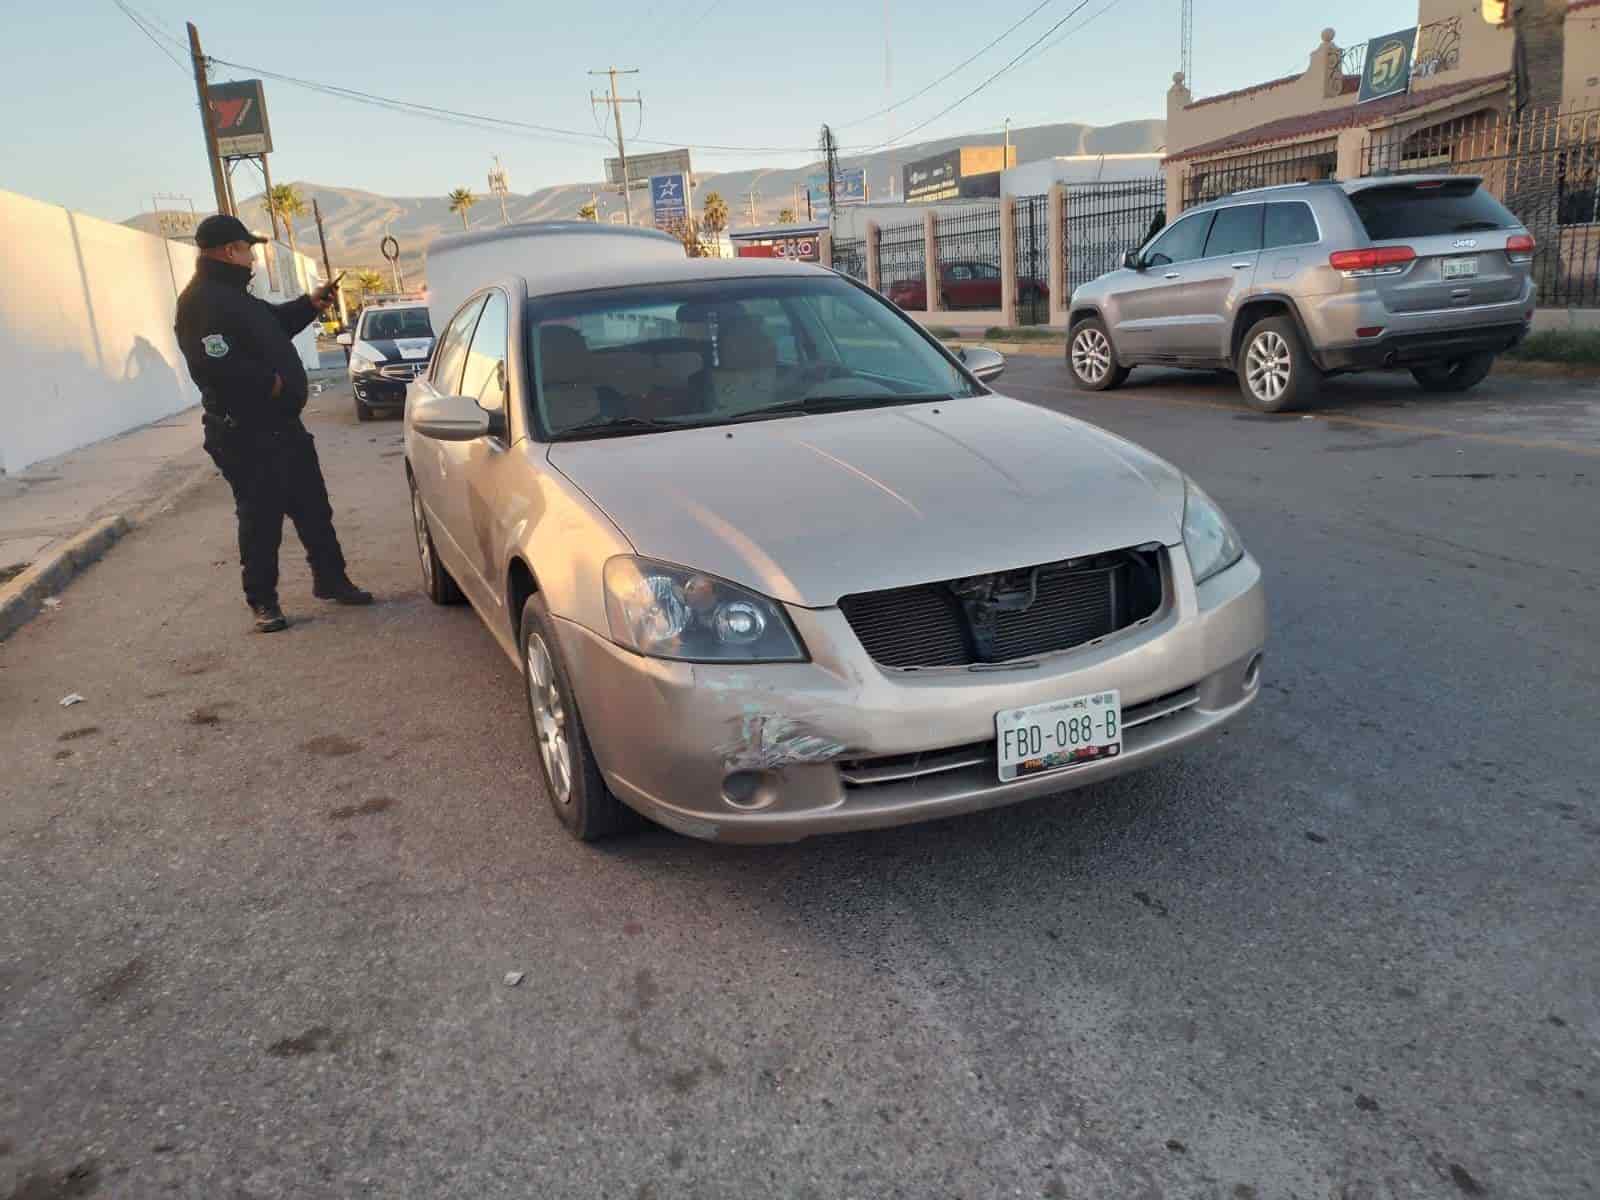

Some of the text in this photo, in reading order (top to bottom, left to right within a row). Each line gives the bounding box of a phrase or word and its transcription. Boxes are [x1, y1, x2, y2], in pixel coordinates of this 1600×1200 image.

[1373, 46, 1403, 86] 57
[1452, 239, 1477, 248] Jeep
[1003, 709, 1117, 760] FBD-088-B
